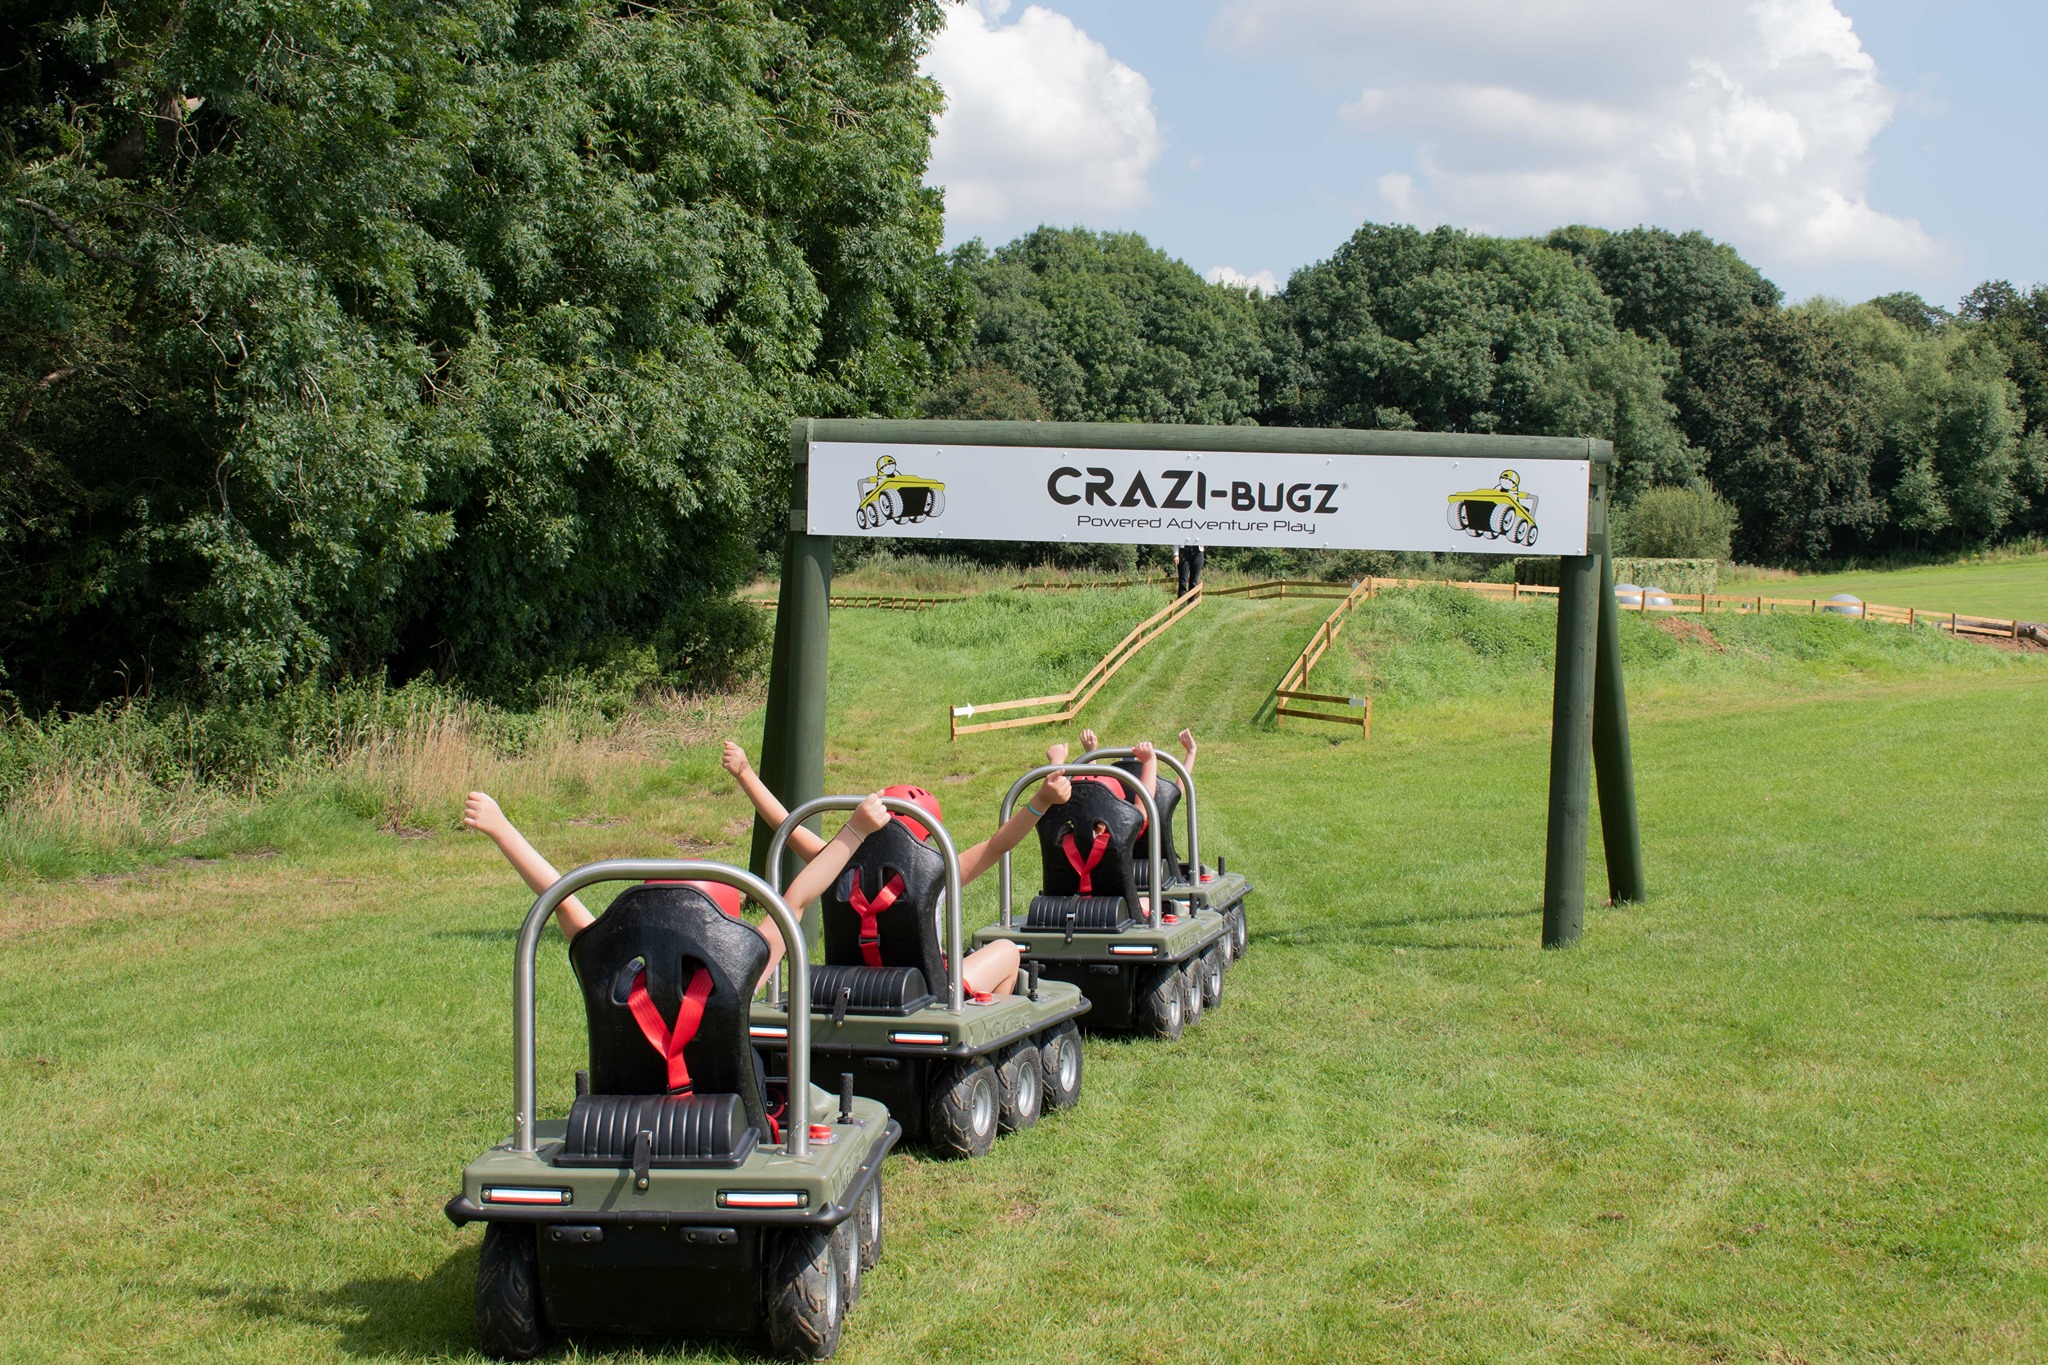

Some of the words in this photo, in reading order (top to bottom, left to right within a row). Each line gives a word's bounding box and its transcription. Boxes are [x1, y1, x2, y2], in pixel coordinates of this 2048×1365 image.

[1077, 515, 1162, 529] Powered
[1166, 517, 1269, 532] Adventure
[1273, 520, 1316, 535] Play
